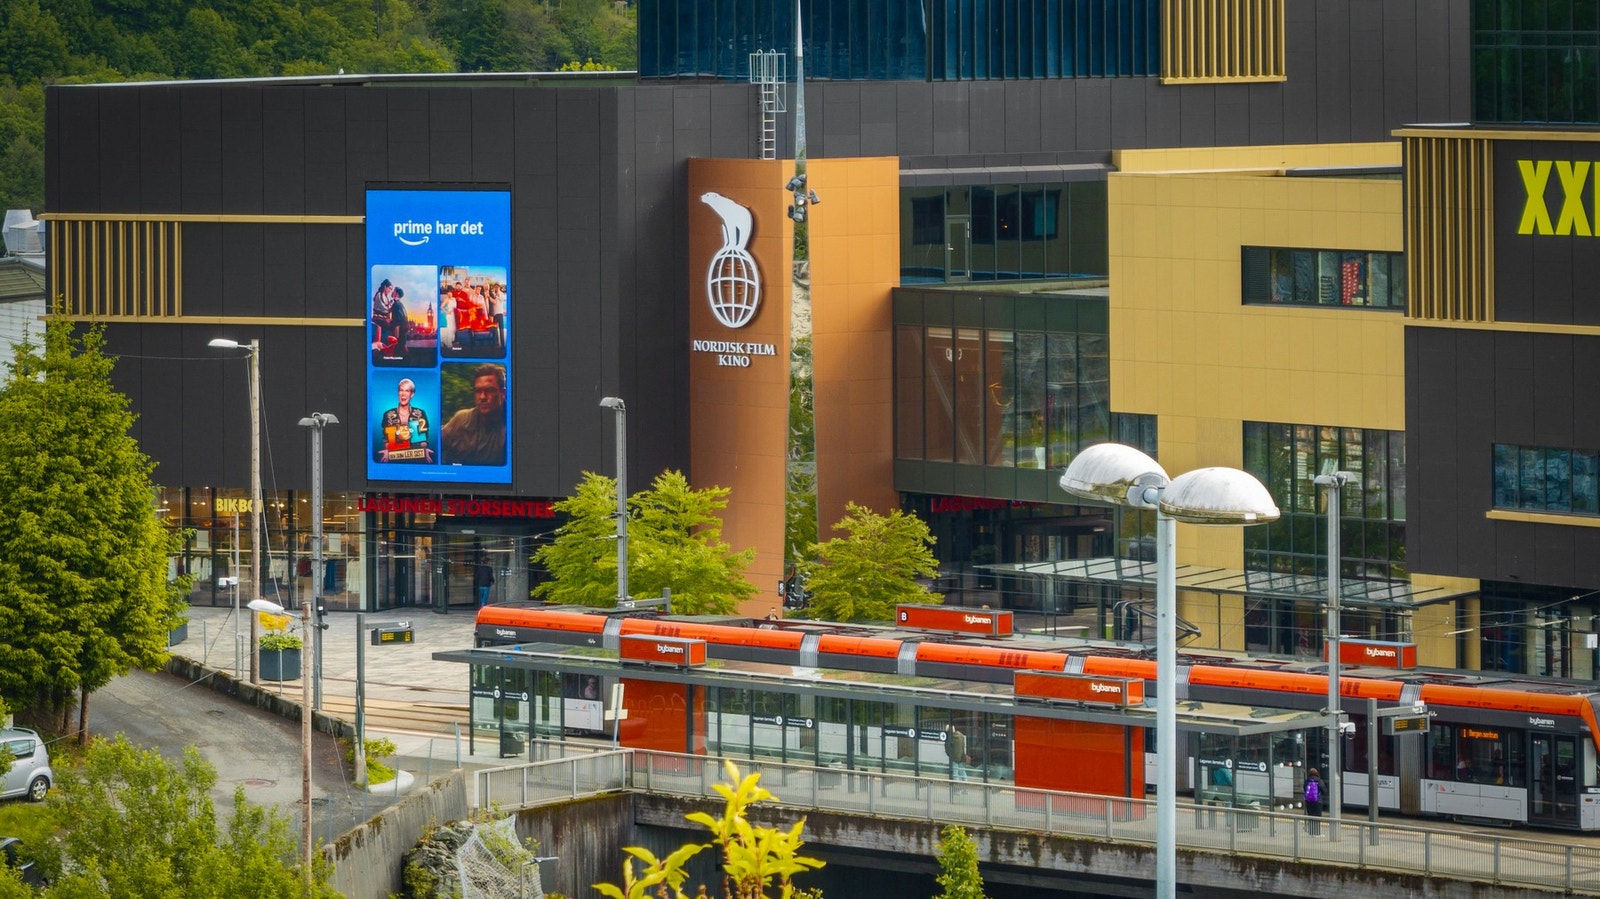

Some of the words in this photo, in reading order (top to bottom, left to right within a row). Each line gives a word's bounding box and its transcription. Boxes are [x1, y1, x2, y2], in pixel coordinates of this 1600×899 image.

[394, 220, 432, 237] prime
[436, 220, 458, 235] har
[460, 221, 484, 235] det
[693, 340, 744, 354] NORDISK
[747, 343, 776, 356] FILM
[718, 354, 750, 367] KINO
[358, 497, 443, 514] LAGUNEN
[447, 499, 555, 518] STORSENTER
[931, 495, 1007, 513] LAGUNEN
[900, 612, 907, 621] B
[965, 614, 992, 625] bybanen
[657, 643, 684, 654] bybanen
[1366, 647, 1396, 657] bybanen
[1091, 682, 1121, 693] bybanen
[1529, 716, 1555, 726] bybanen
